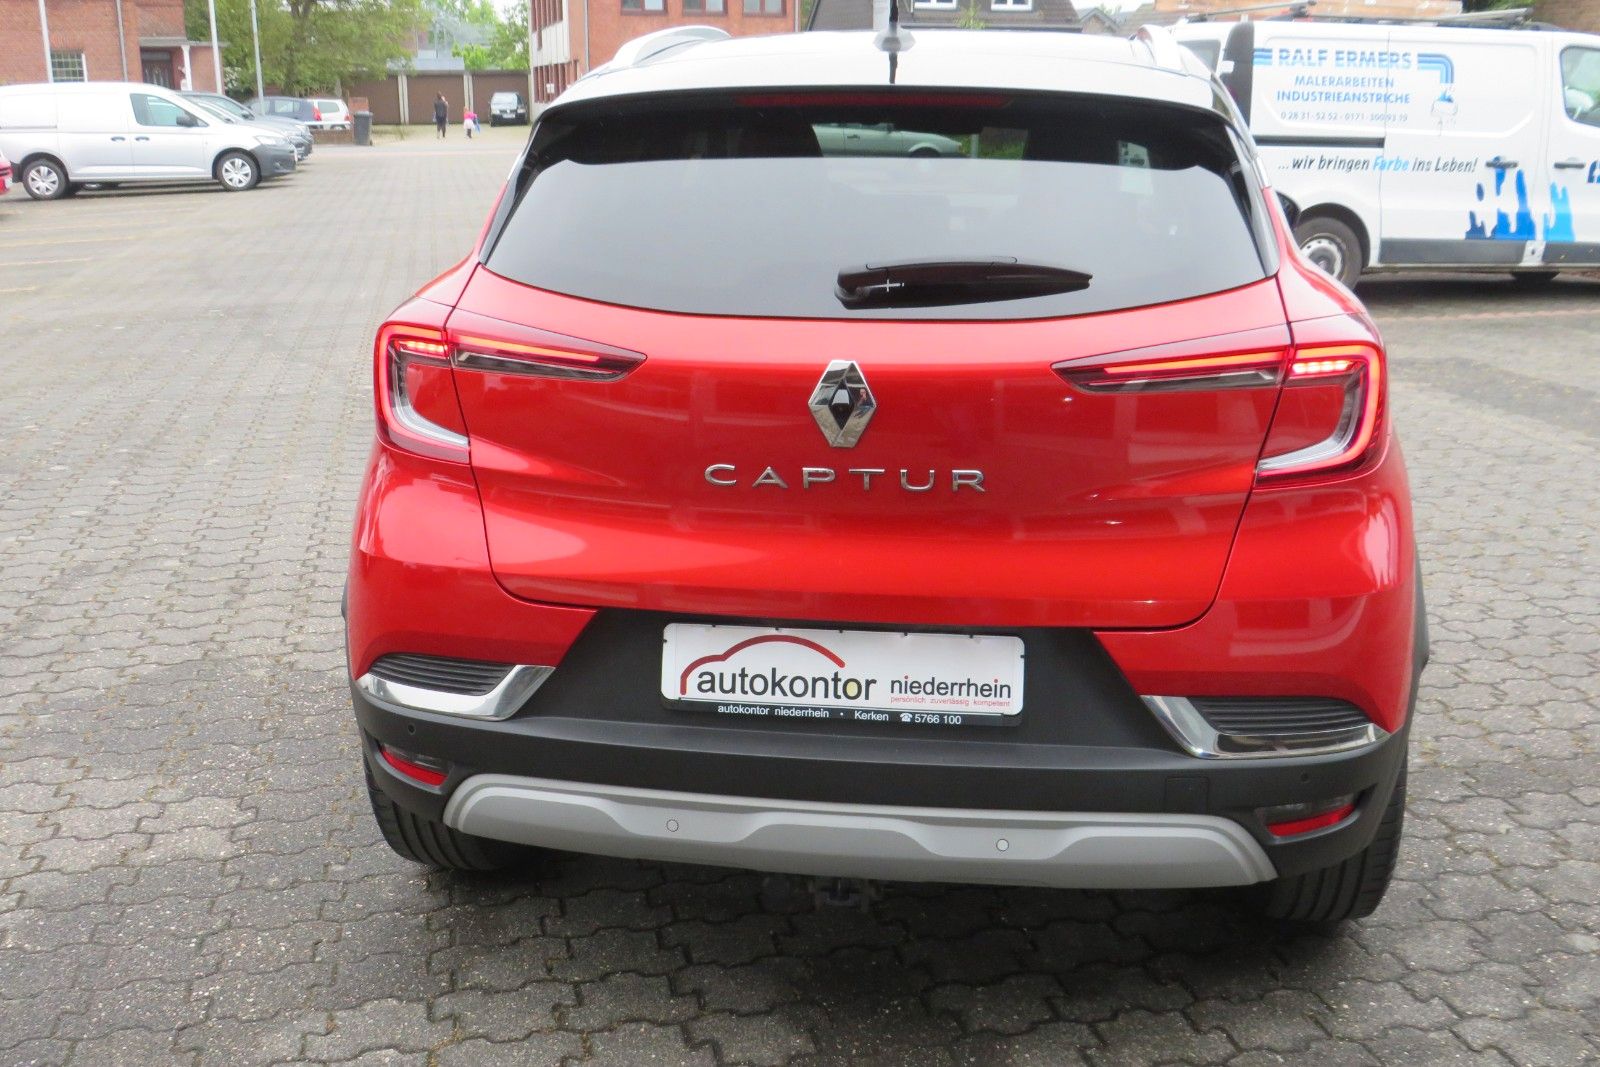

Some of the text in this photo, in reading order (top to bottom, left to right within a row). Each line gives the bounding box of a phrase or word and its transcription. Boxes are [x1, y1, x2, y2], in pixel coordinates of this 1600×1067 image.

[1278, 47, 1412, 69] RALF ERMERS
[1294, 75, 1394, 88] MALERARBEITEN
[1277, 90, 1411, 104] INDUSTRIEANSTRICHE
[1317, 155, 1370, 173] bringen
[1373, 155, 1409, 172] Farbe
[1412, 157, 1431, 172] ins
[1435, 156, 1479, 173] Leben!
[703, 463, 986, 493] CAPTUR
[697, 666, 1011, 700] autokontor niederrhein
[890, 696, 1010, 708] persönlich zuverlässig kompetent
[717, 704, 962, 725] autokontor niederrhein Kerken 5766 100
